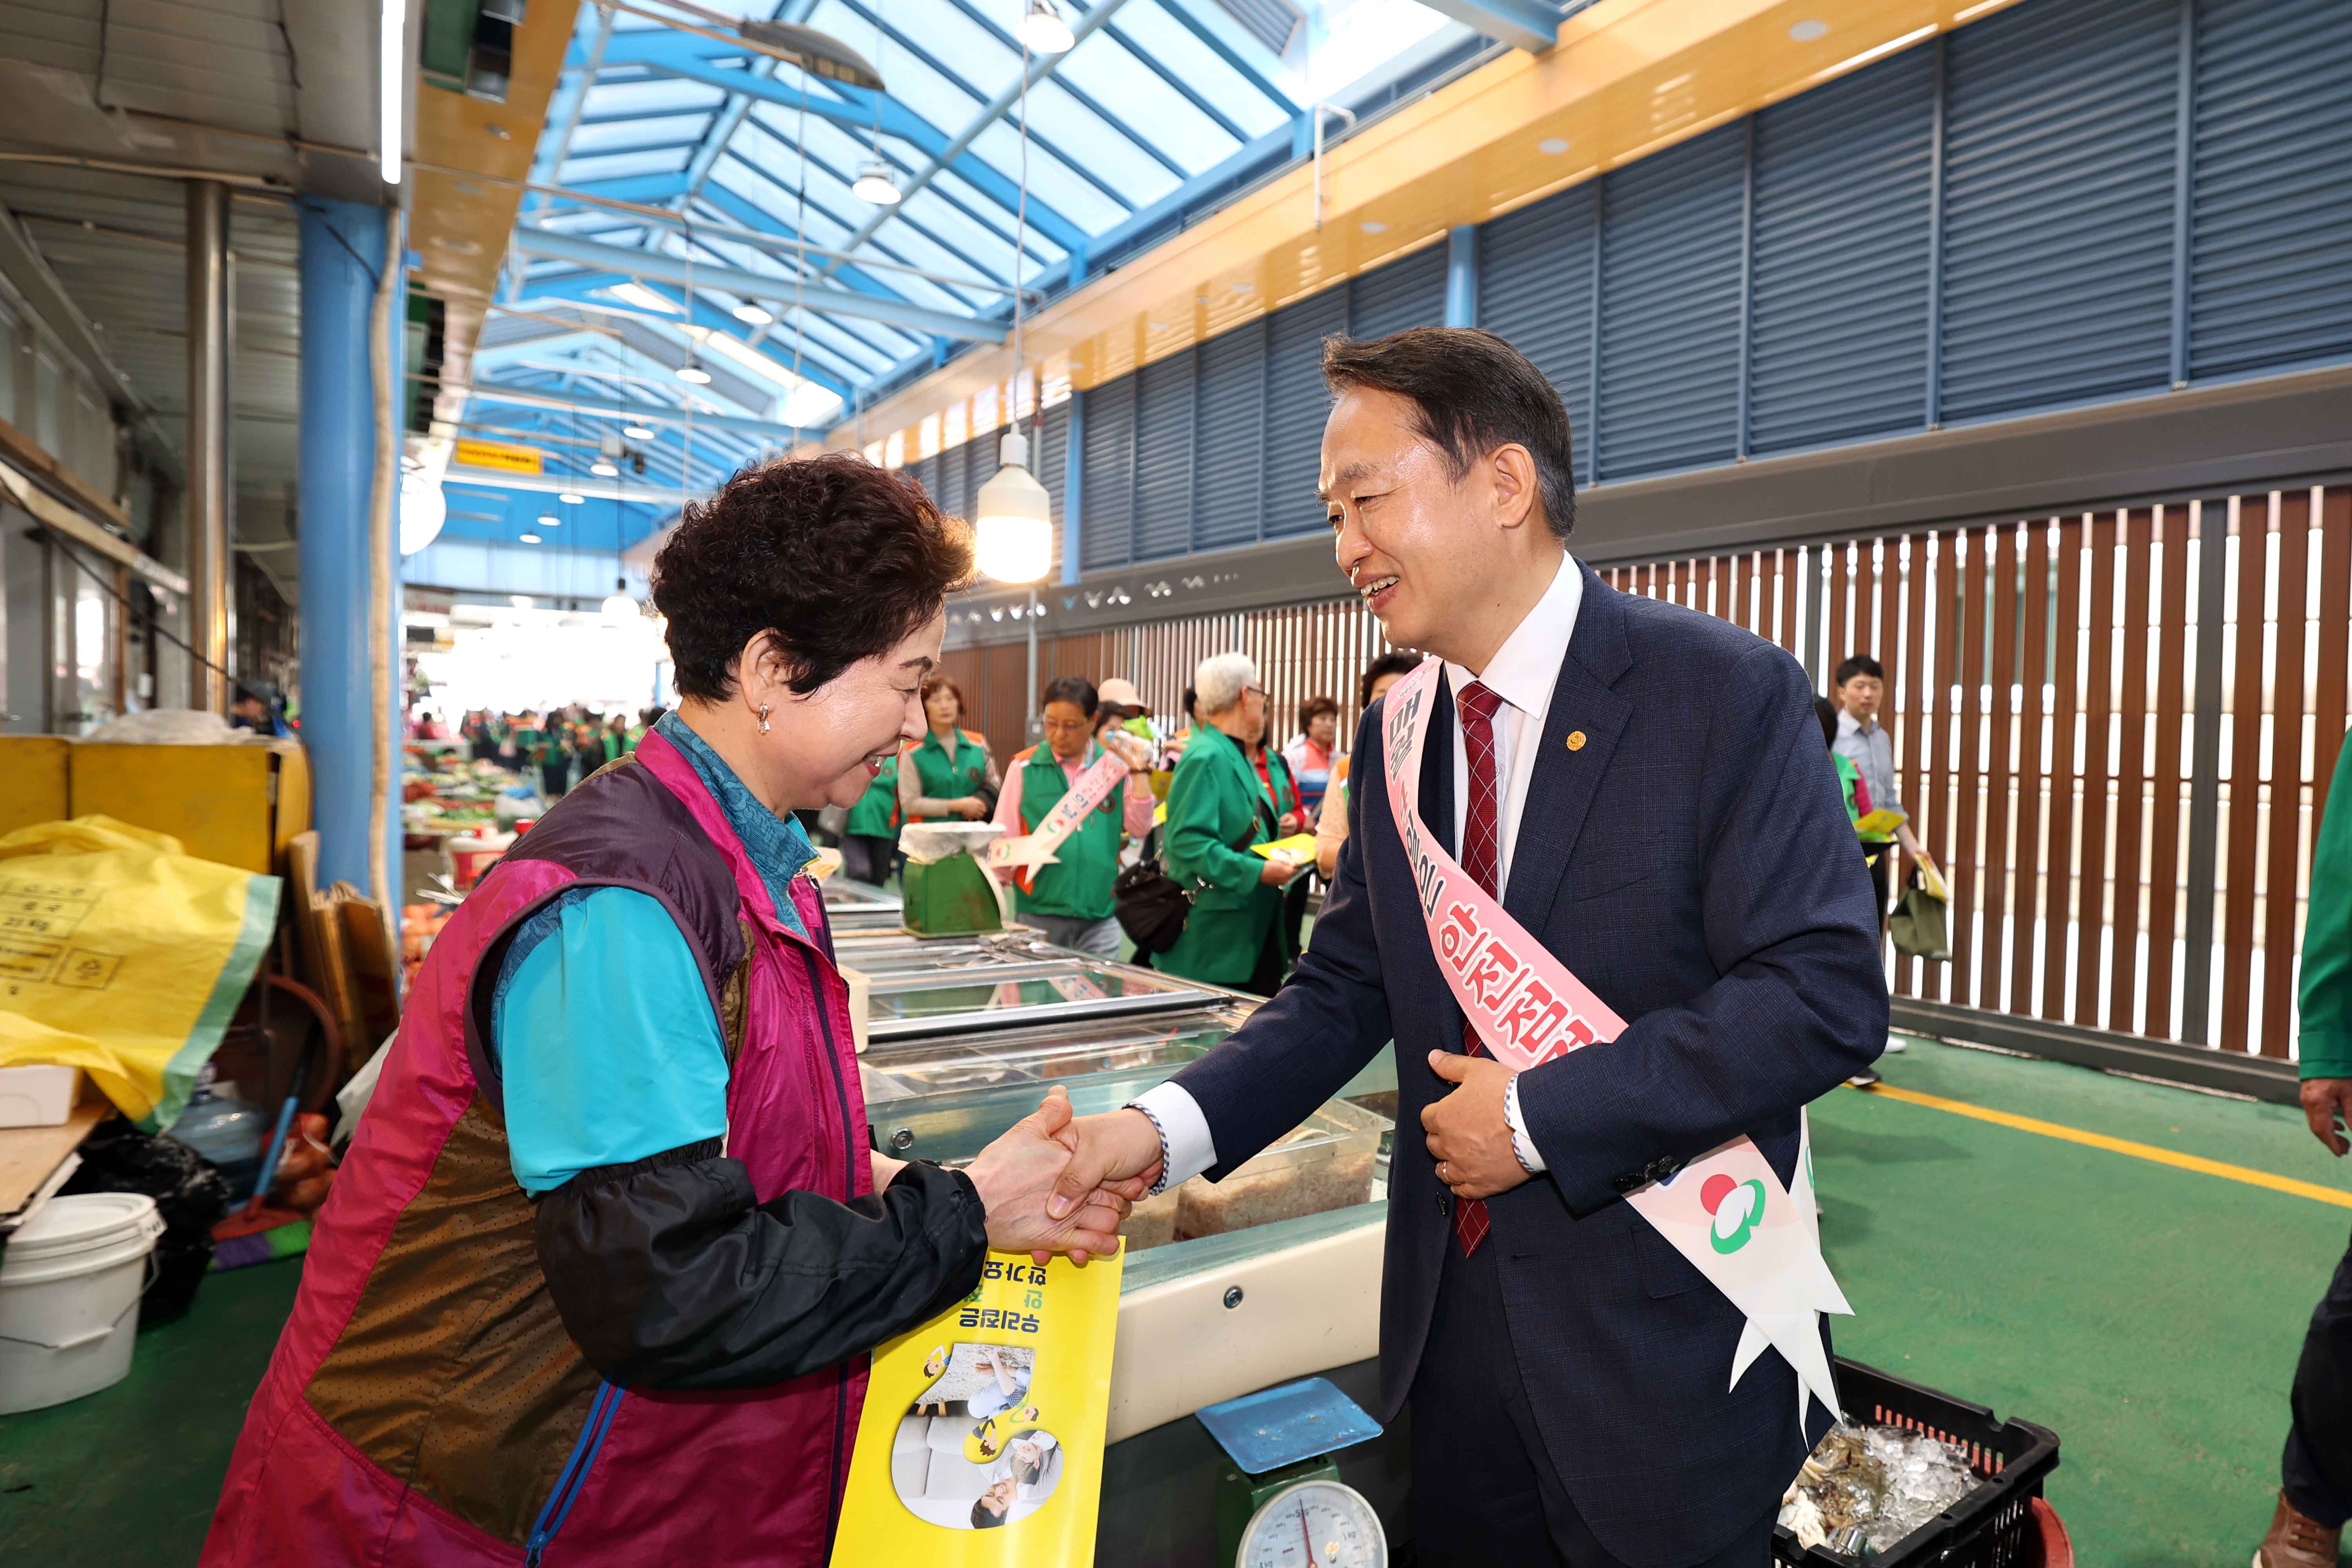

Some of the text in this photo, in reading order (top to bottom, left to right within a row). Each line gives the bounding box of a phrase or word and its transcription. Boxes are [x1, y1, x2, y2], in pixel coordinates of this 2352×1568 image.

[1389, 687, 1423, 782] 매월
[984, 1261, 1046, 1286] 한가요
[959, 1308, 1040, 1333] 우리집은
